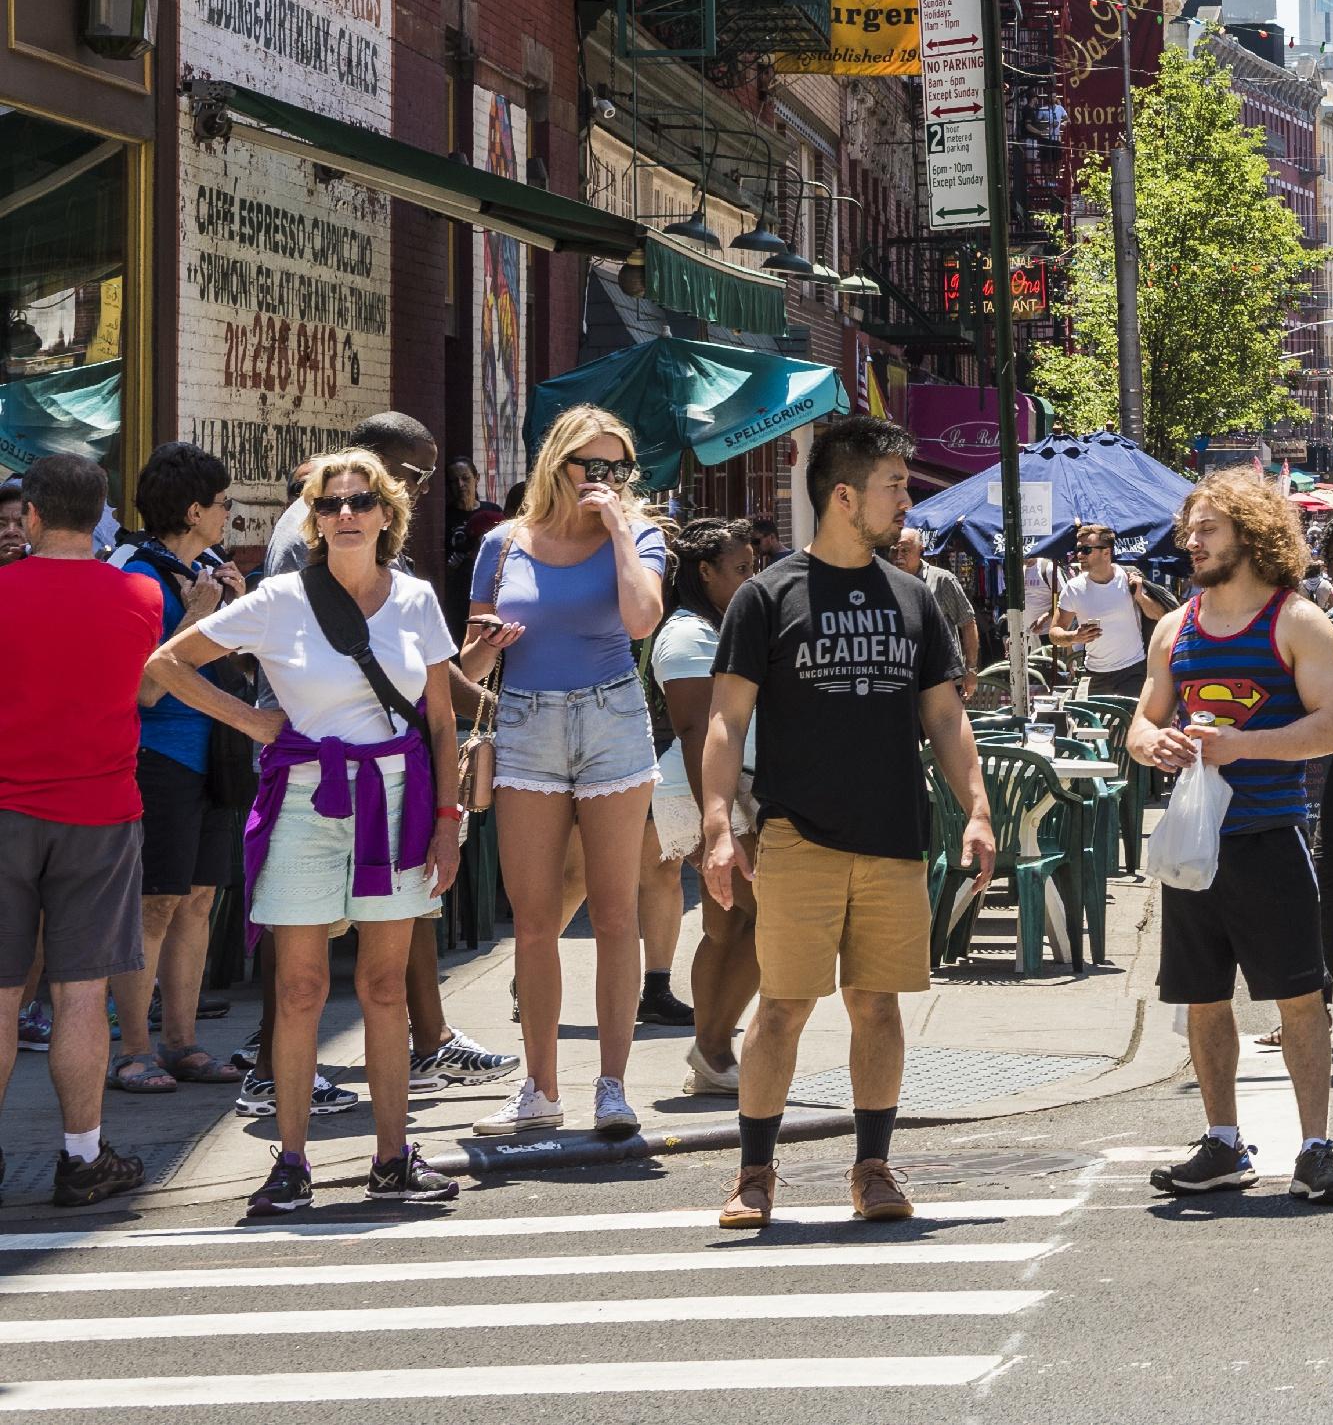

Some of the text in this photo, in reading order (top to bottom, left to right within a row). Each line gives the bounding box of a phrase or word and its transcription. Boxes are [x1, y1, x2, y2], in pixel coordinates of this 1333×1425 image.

[830, 6, 919, 33] urger
[924, 9, 951, 20] Holidays
[336, 26, 379, 98] CAKES
[927, 55, 984, 74] NO PARKING
[928, 75, 965, 89] 8am 6pm
[928, 87, 979, 102] Except Sunday
[929, 125, 959, 152] 2 hour
[946, 132, 972, 143] metered
[946, 143, 969, 154] parking
[932, 162, 972, 176] 6pm 10pm
[932, 174, 984, 188] Except Sunday
[238, 197, 306, 260] ESPRESSO
[309, 216, 373, 279] CAPPUCCINO
[198, 250, 251, 310] SPUMONI
[255, 264, 294, 319] GELATI
[224, 321, 248, 390] 212
[724, 398, 814, 447] S.PELLEGRINO
[821, 609, 897, 635] ONNIT
[795, 635, 918, 668] ACADEMY
[799, 665, 880, 679] UNCONVENTIONAL
